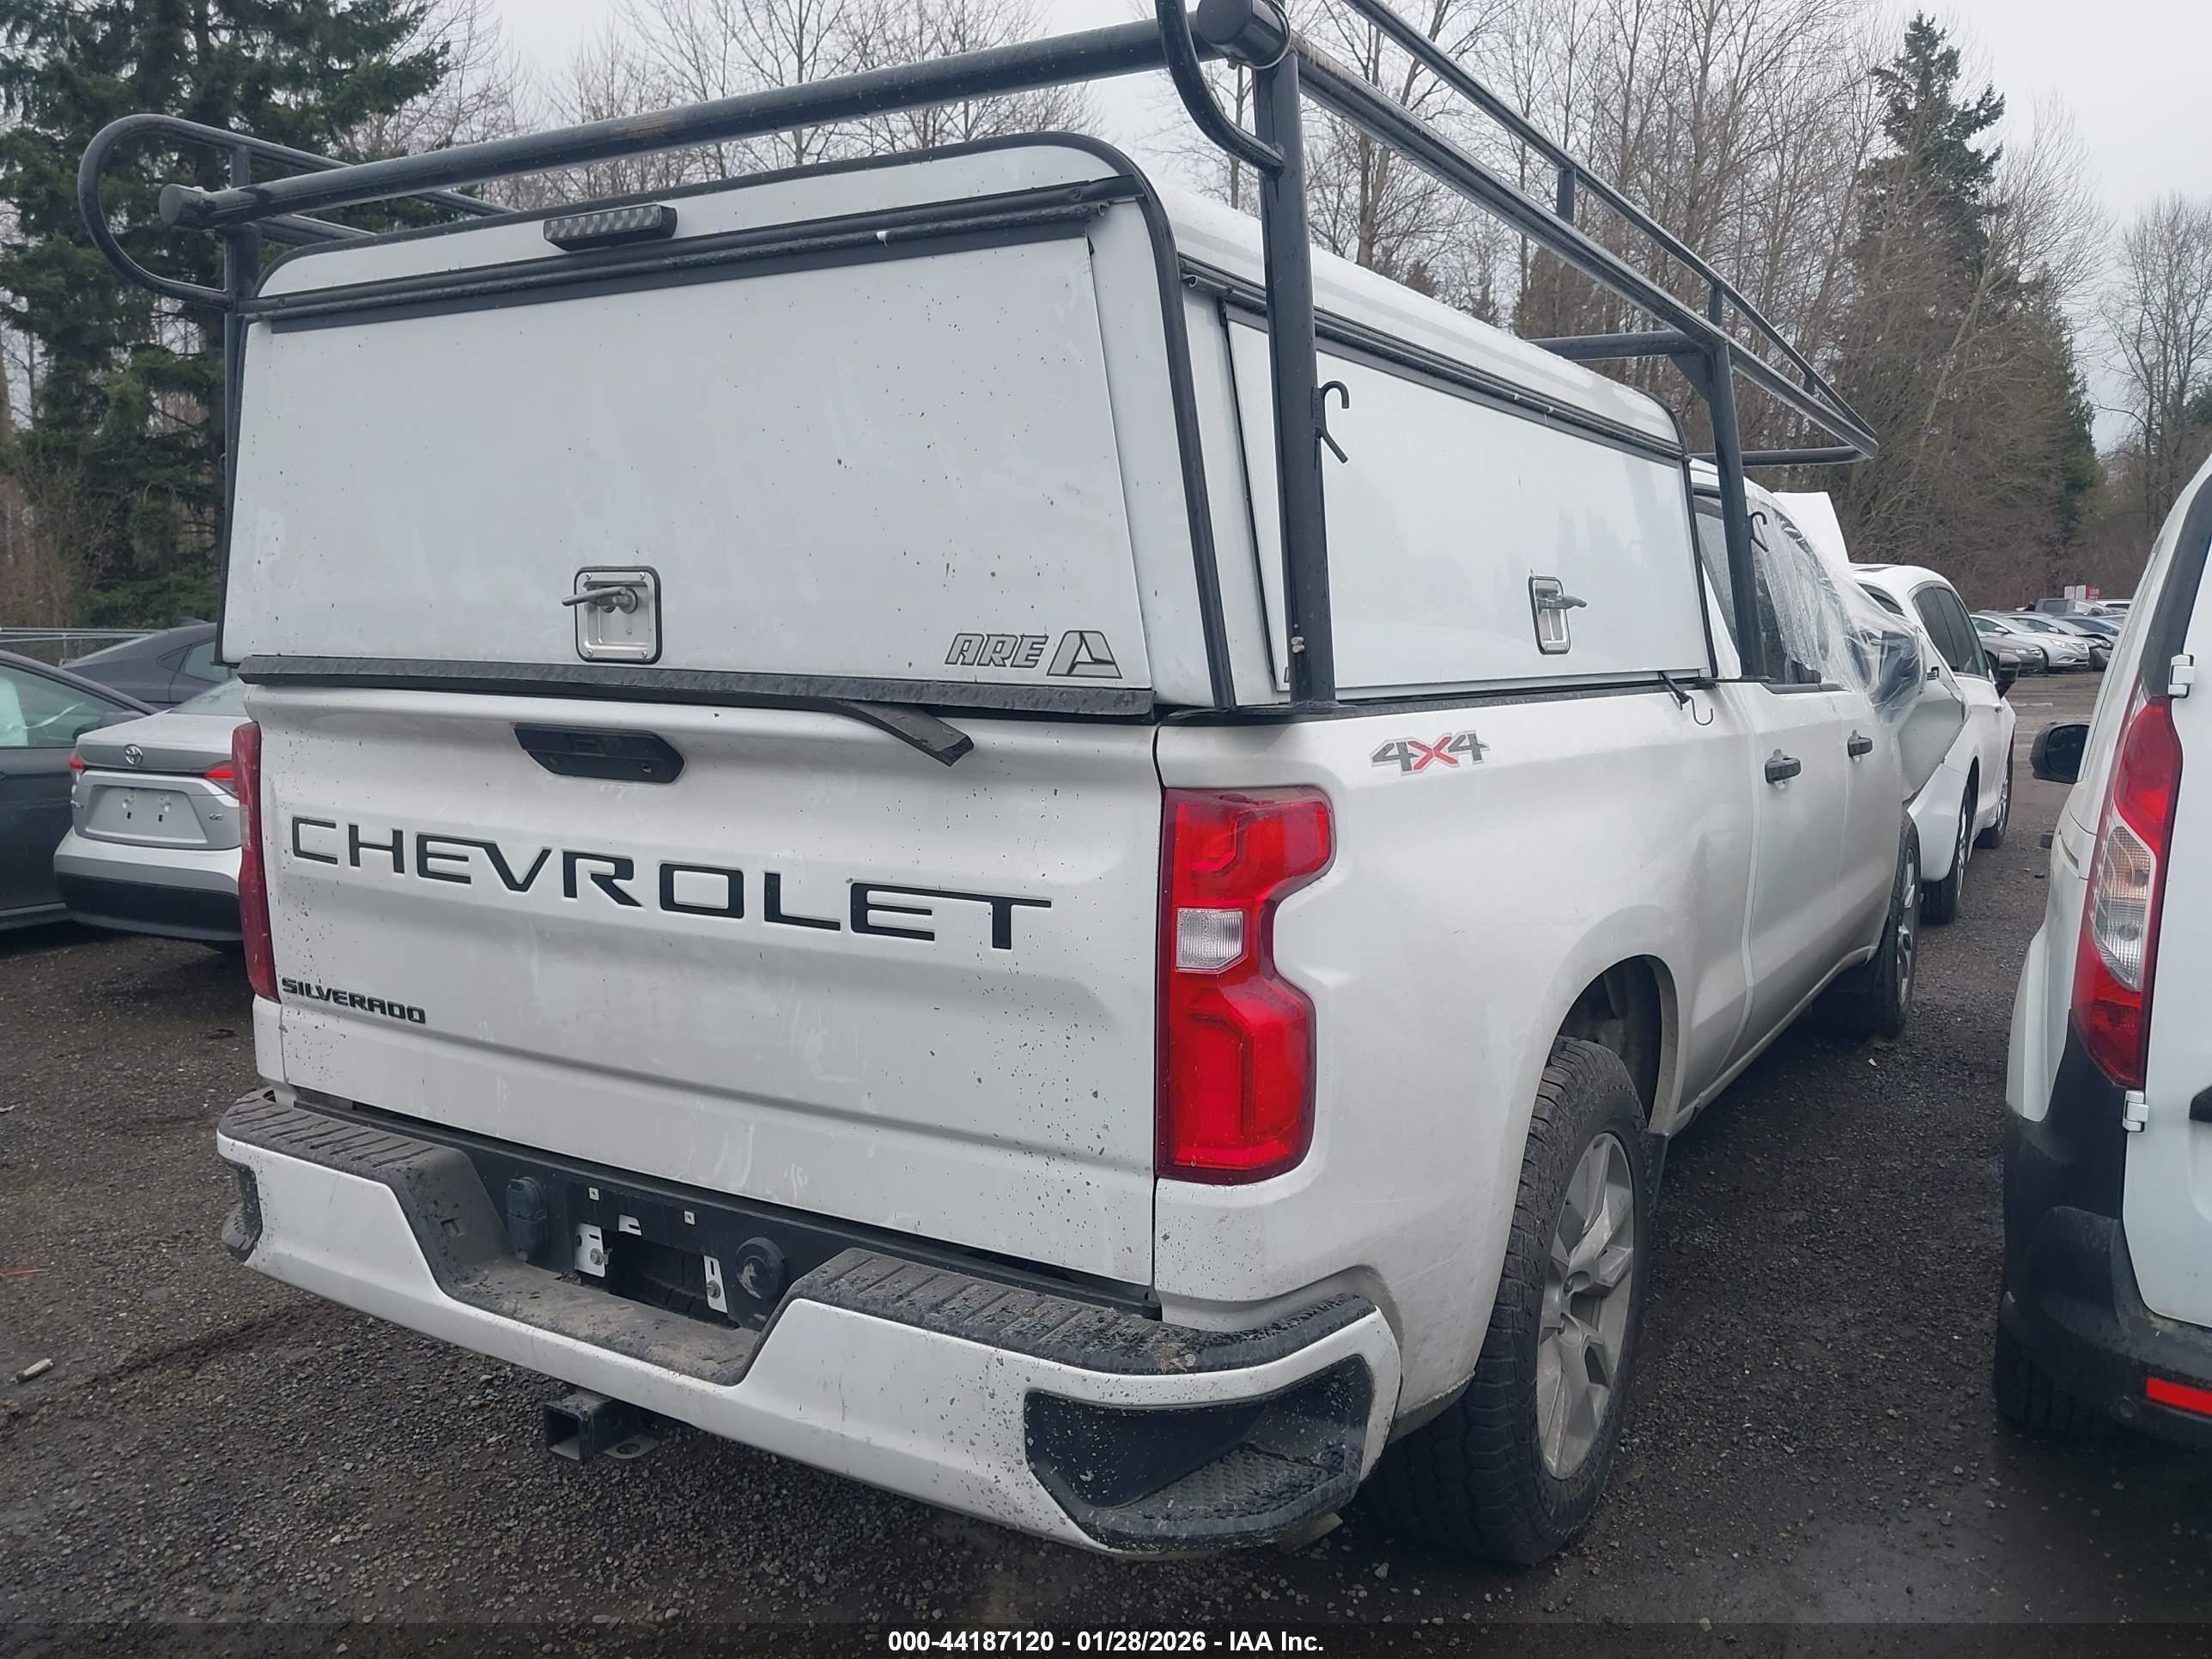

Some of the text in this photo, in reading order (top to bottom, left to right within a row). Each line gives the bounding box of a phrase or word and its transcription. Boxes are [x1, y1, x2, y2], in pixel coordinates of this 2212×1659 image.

[945, 633, 1049, 669] ARE
[292, 816, 1053, 951] CHEVROLET
[281, 976, 427, 1024] SILVERADO
